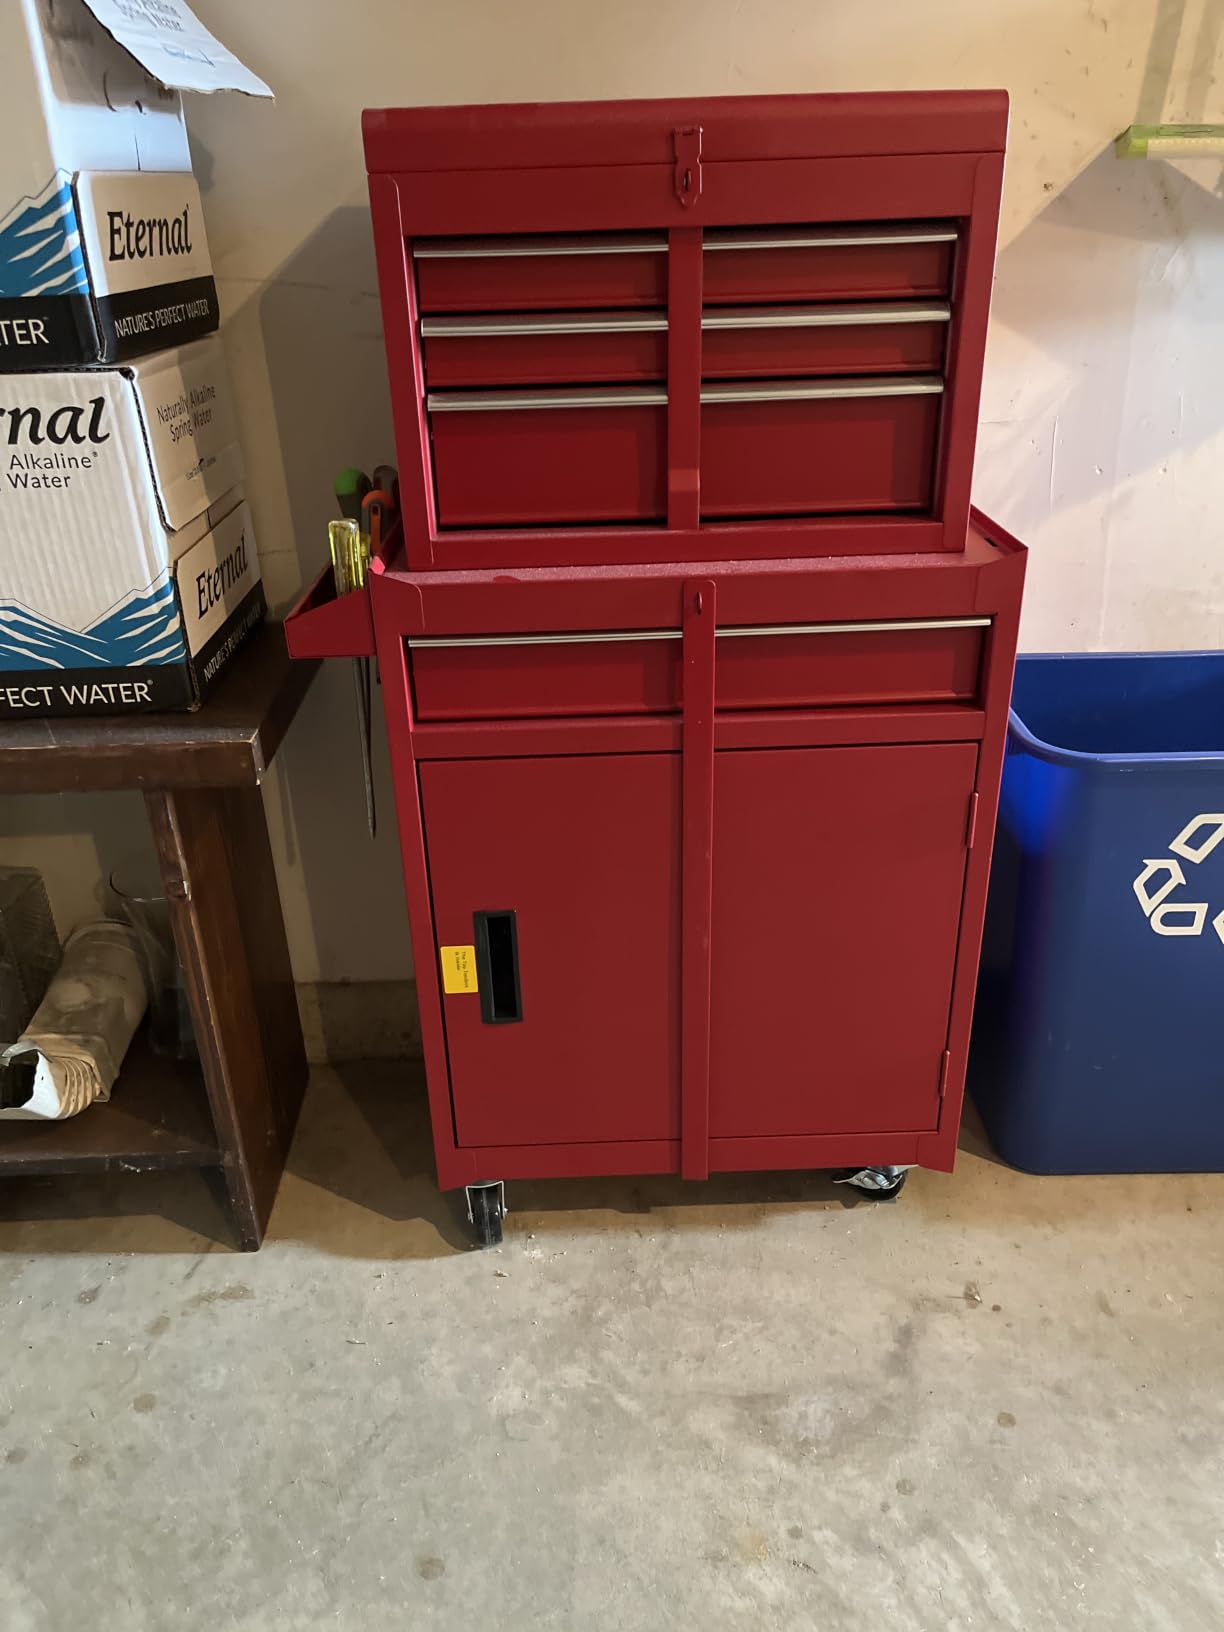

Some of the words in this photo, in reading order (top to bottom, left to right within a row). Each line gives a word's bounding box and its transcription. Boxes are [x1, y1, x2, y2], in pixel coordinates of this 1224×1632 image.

[107, 208, 192, 262] Eternal
[0, 319, 50, 345] TER
[114, 311, 155, 338] NATURE'S
[155, 304, 186, 328] PERFECT
[185, 299, 210, 319] WATER
[157, 395, 190, 424] Naturally
[170, 420, 193, 444] Spring
[193, 408, 212, 430] Water
[7, 473, 71, 489] Water
[196, 534, 249, 619] Eternal
